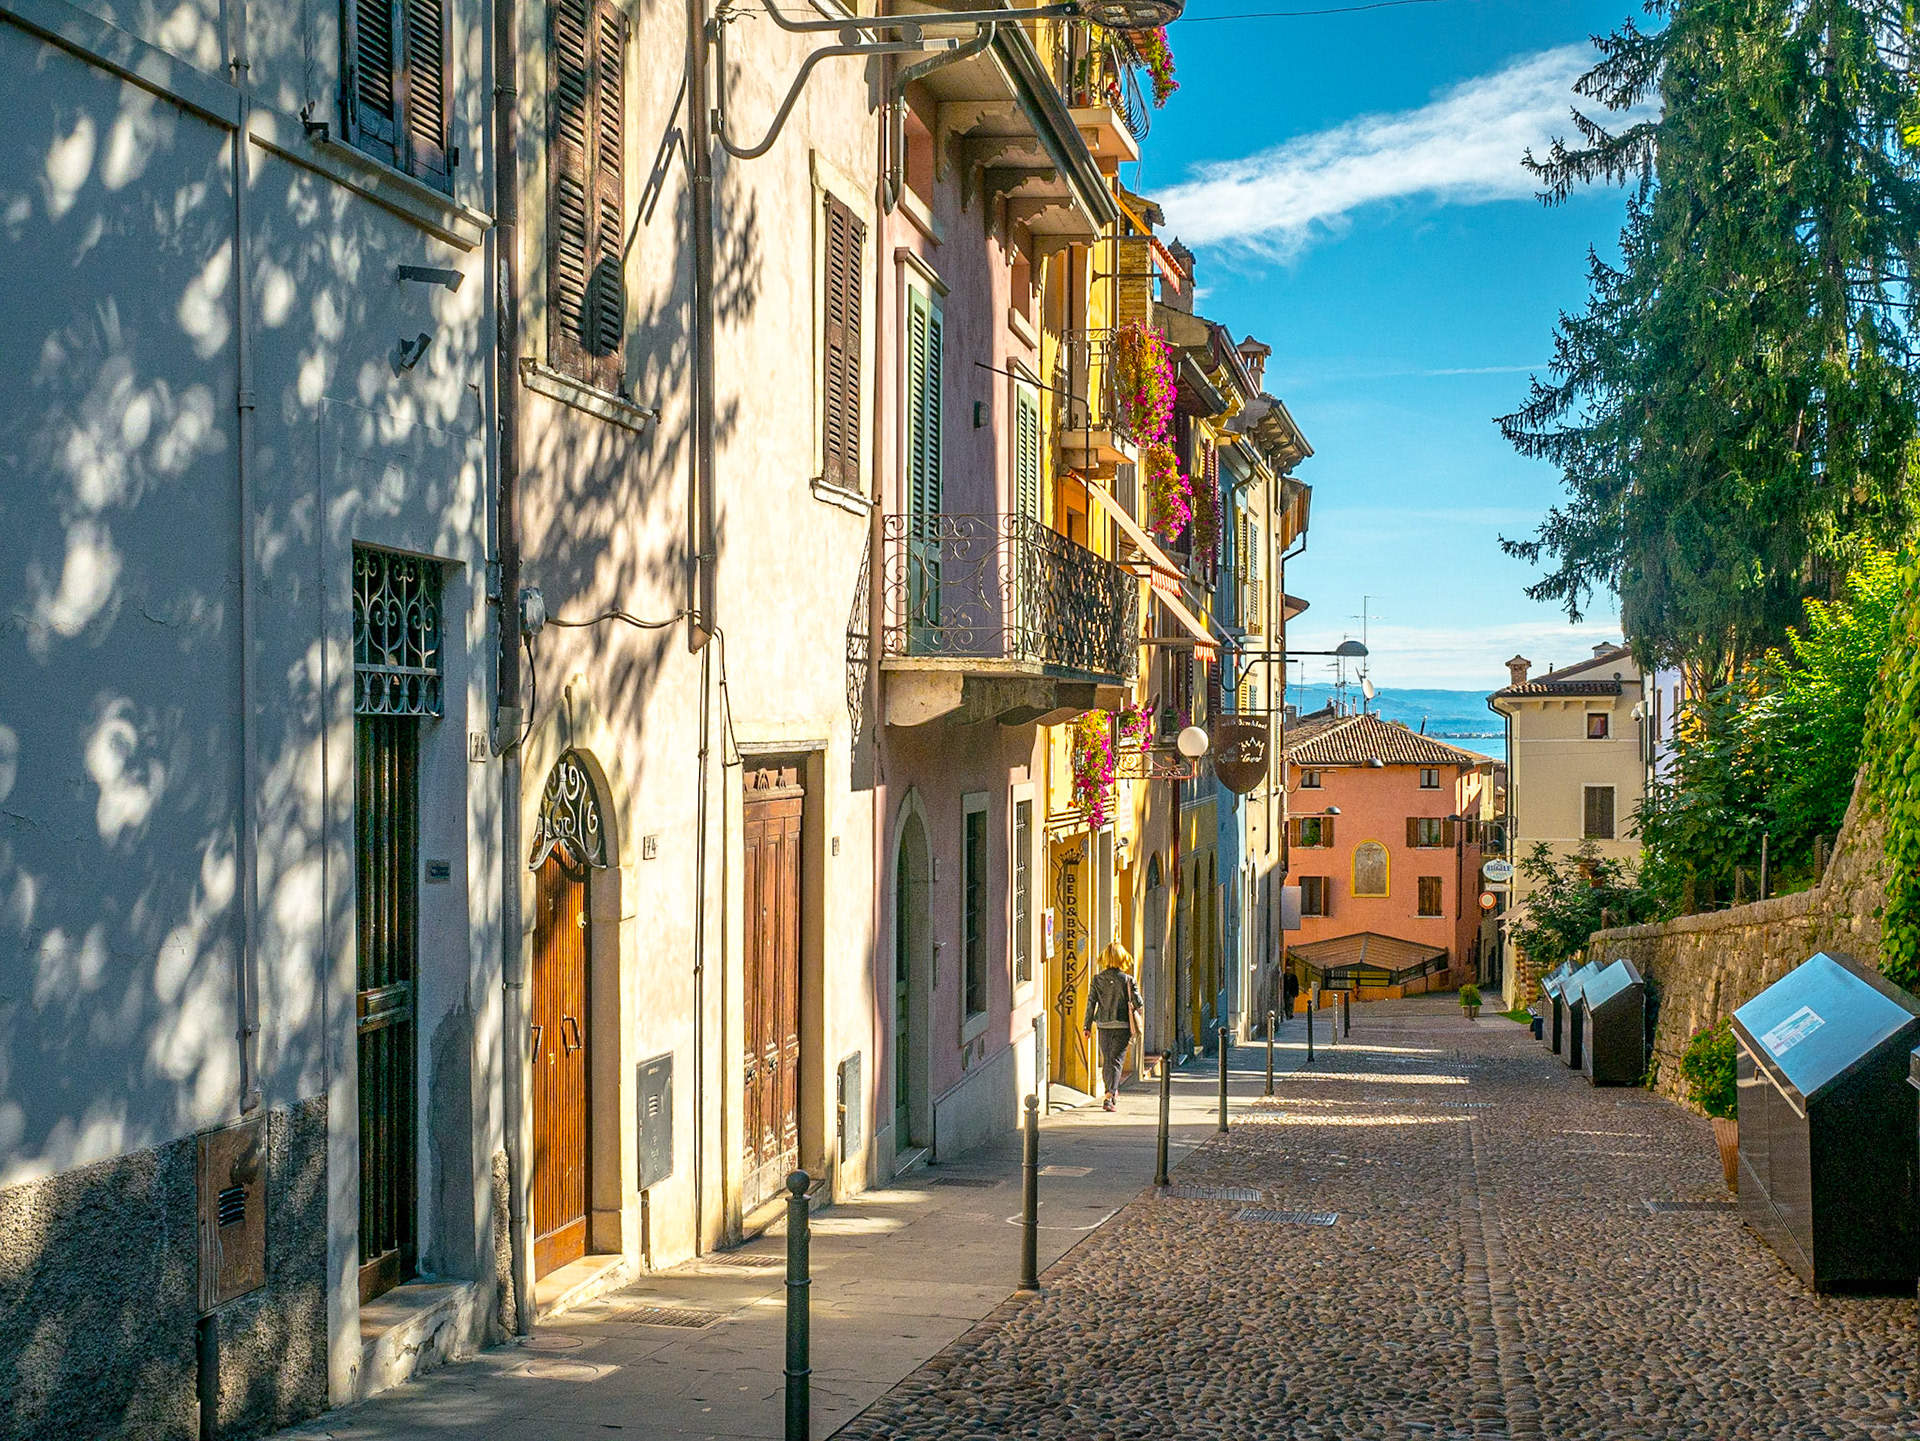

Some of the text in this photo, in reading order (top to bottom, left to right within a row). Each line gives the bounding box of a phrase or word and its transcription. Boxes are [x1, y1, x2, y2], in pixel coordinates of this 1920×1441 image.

[474, 735, 486, 757] 76
[646, 837, 657, 856] 74
[1065, 873, 1078, 1016] BED&BREAKFAST
